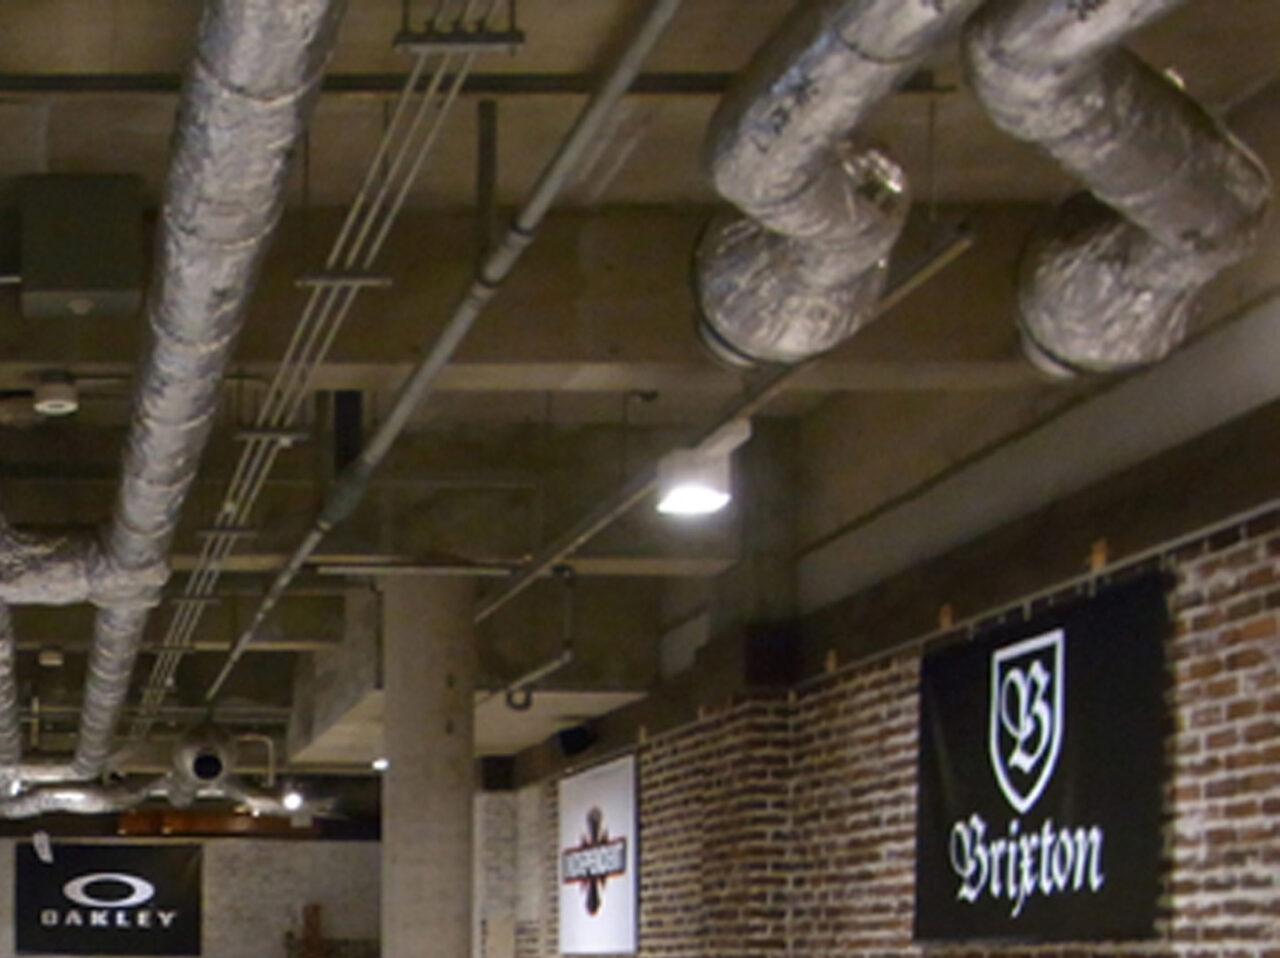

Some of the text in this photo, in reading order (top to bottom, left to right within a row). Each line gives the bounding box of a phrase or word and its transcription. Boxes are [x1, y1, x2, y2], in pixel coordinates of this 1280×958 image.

[1001, 660, 1051, 773] B
[950, 813, 1104, 918] Brixton
[40, 911, 176, 927] OAKLEY
